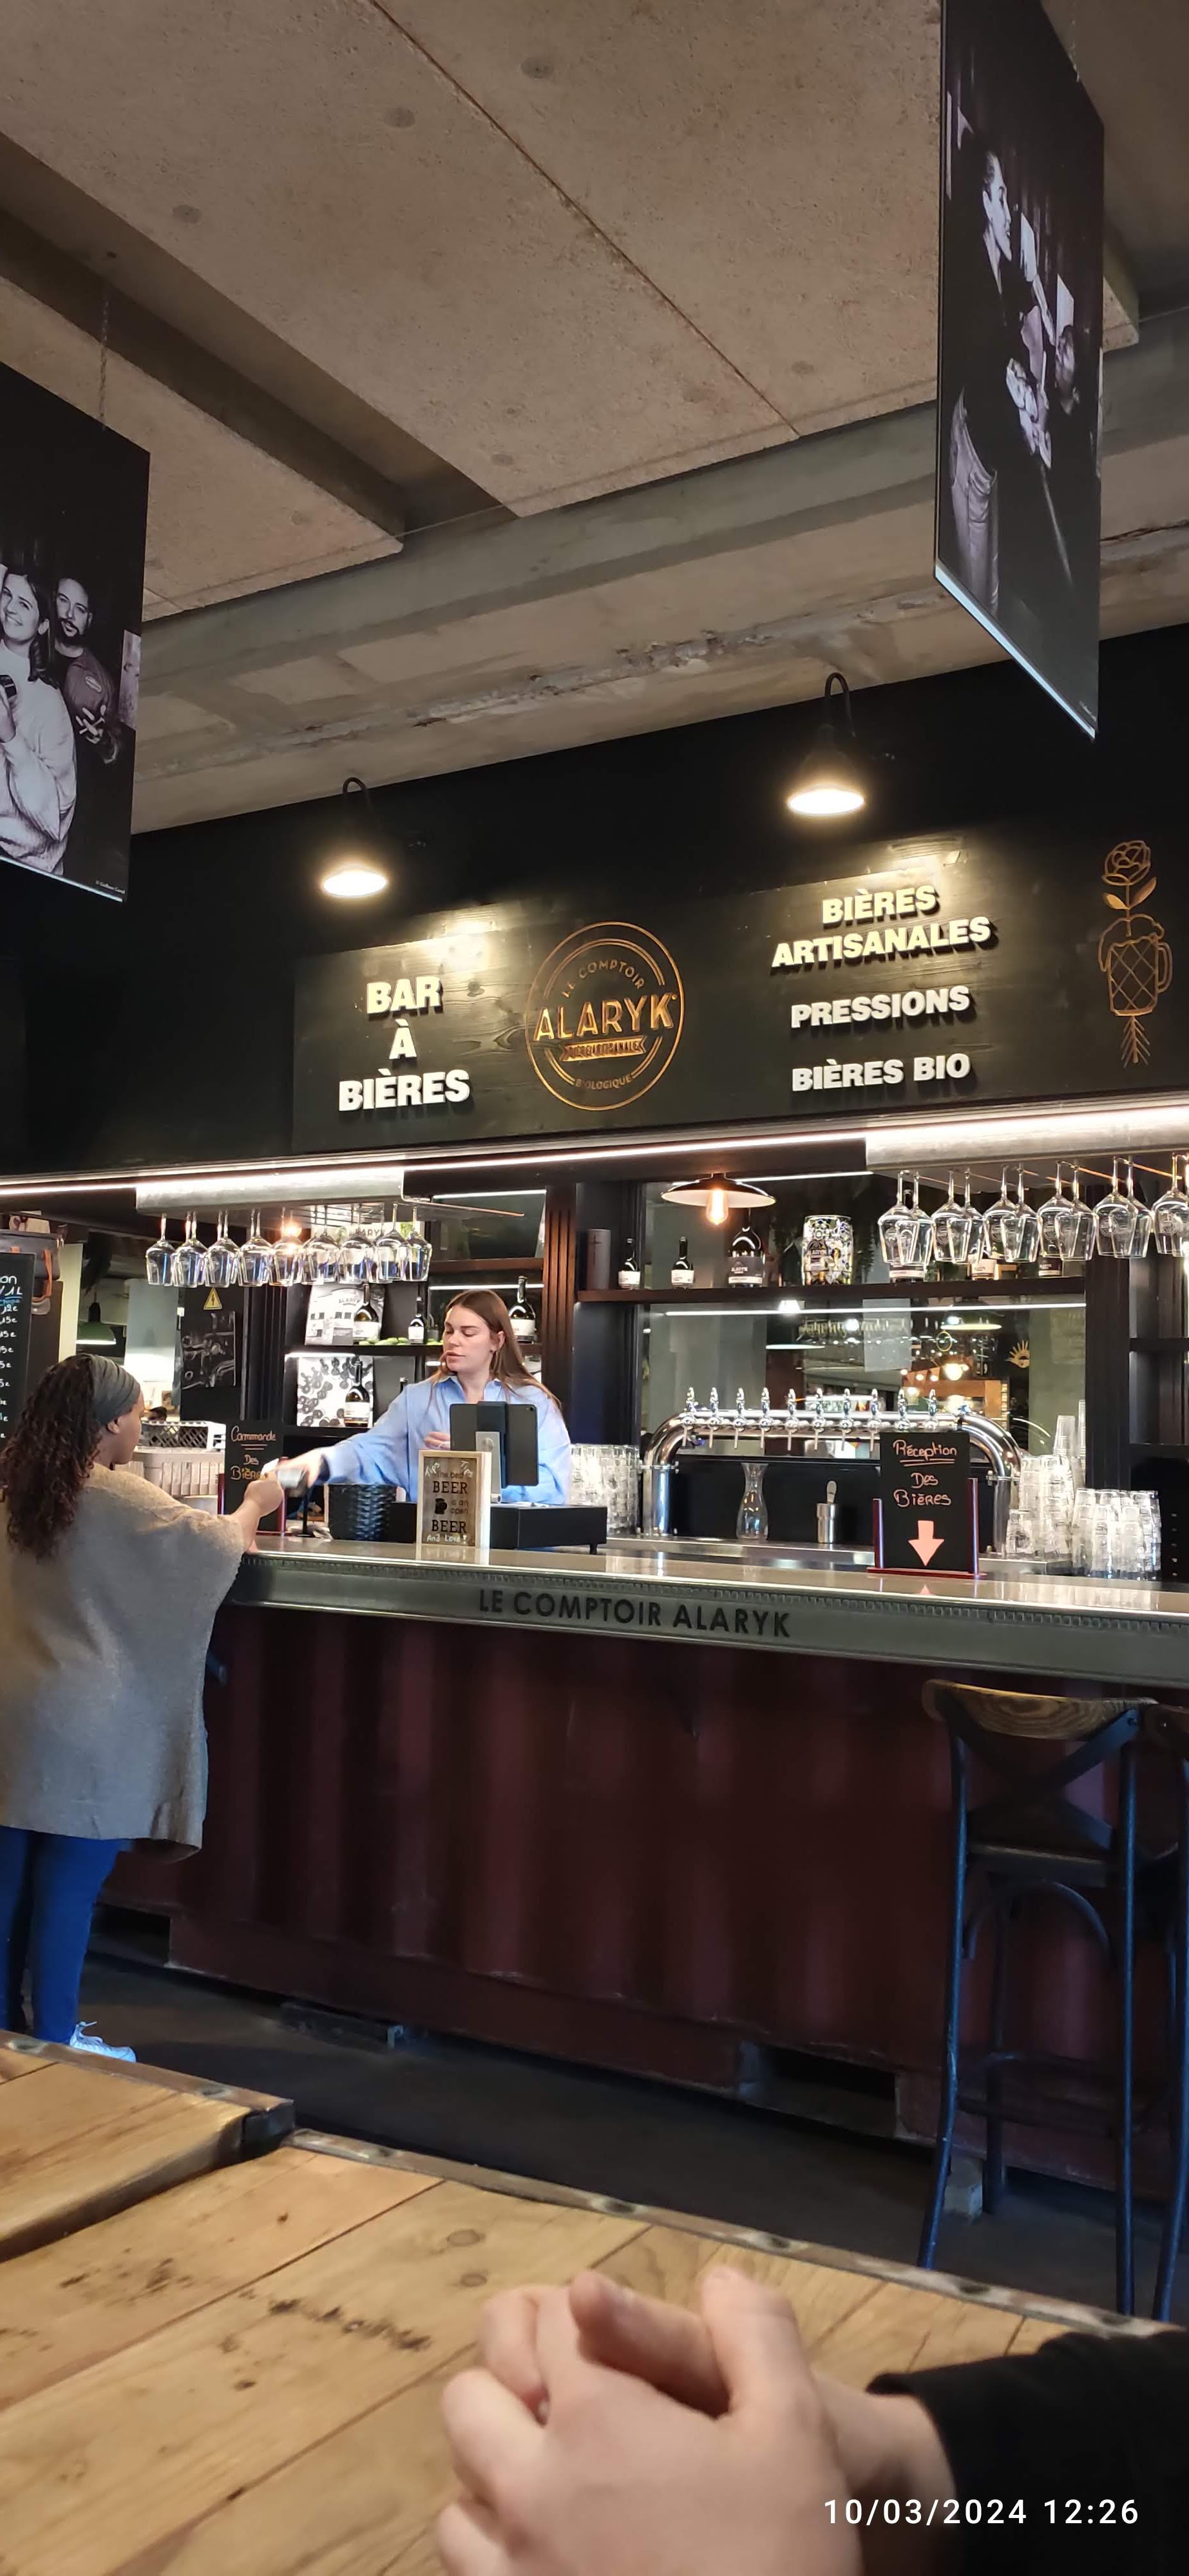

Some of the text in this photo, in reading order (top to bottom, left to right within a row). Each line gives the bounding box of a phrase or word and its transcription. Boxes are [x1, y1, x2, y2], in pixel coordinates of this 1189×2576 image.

[823, 885, 937, 924] BIÈRES
[772, 916, 992, 967] ARTISANALES
[578, 958, 645, 990] COMPTOIR
[366, 976, 442, 1014] BAR
[792, 985, 971, 1028] PRESSIONS
[533, 993, 674, 1041] ALARYK
[389, 1019, 417, 1060] À
[339, 1068, 471, 1112] BIÈRES
[576, 1073, 633, 1090] BIOLOGIQUE
[792, 1053, 971, 1092] BIÈRES BIO
[231, 1425, 276, 1442] Commande
[893, 1439, 957, 1461] Réception
[243, 1454, 259, 1465] Des
[432, 1481, 468, 1494] BEER
[910, 1473, 938, 1488] Des
[432, 1519, 467, 1534] BEER
[480, 1589, 791, 1638] LE COMPTOIR ALARYK
